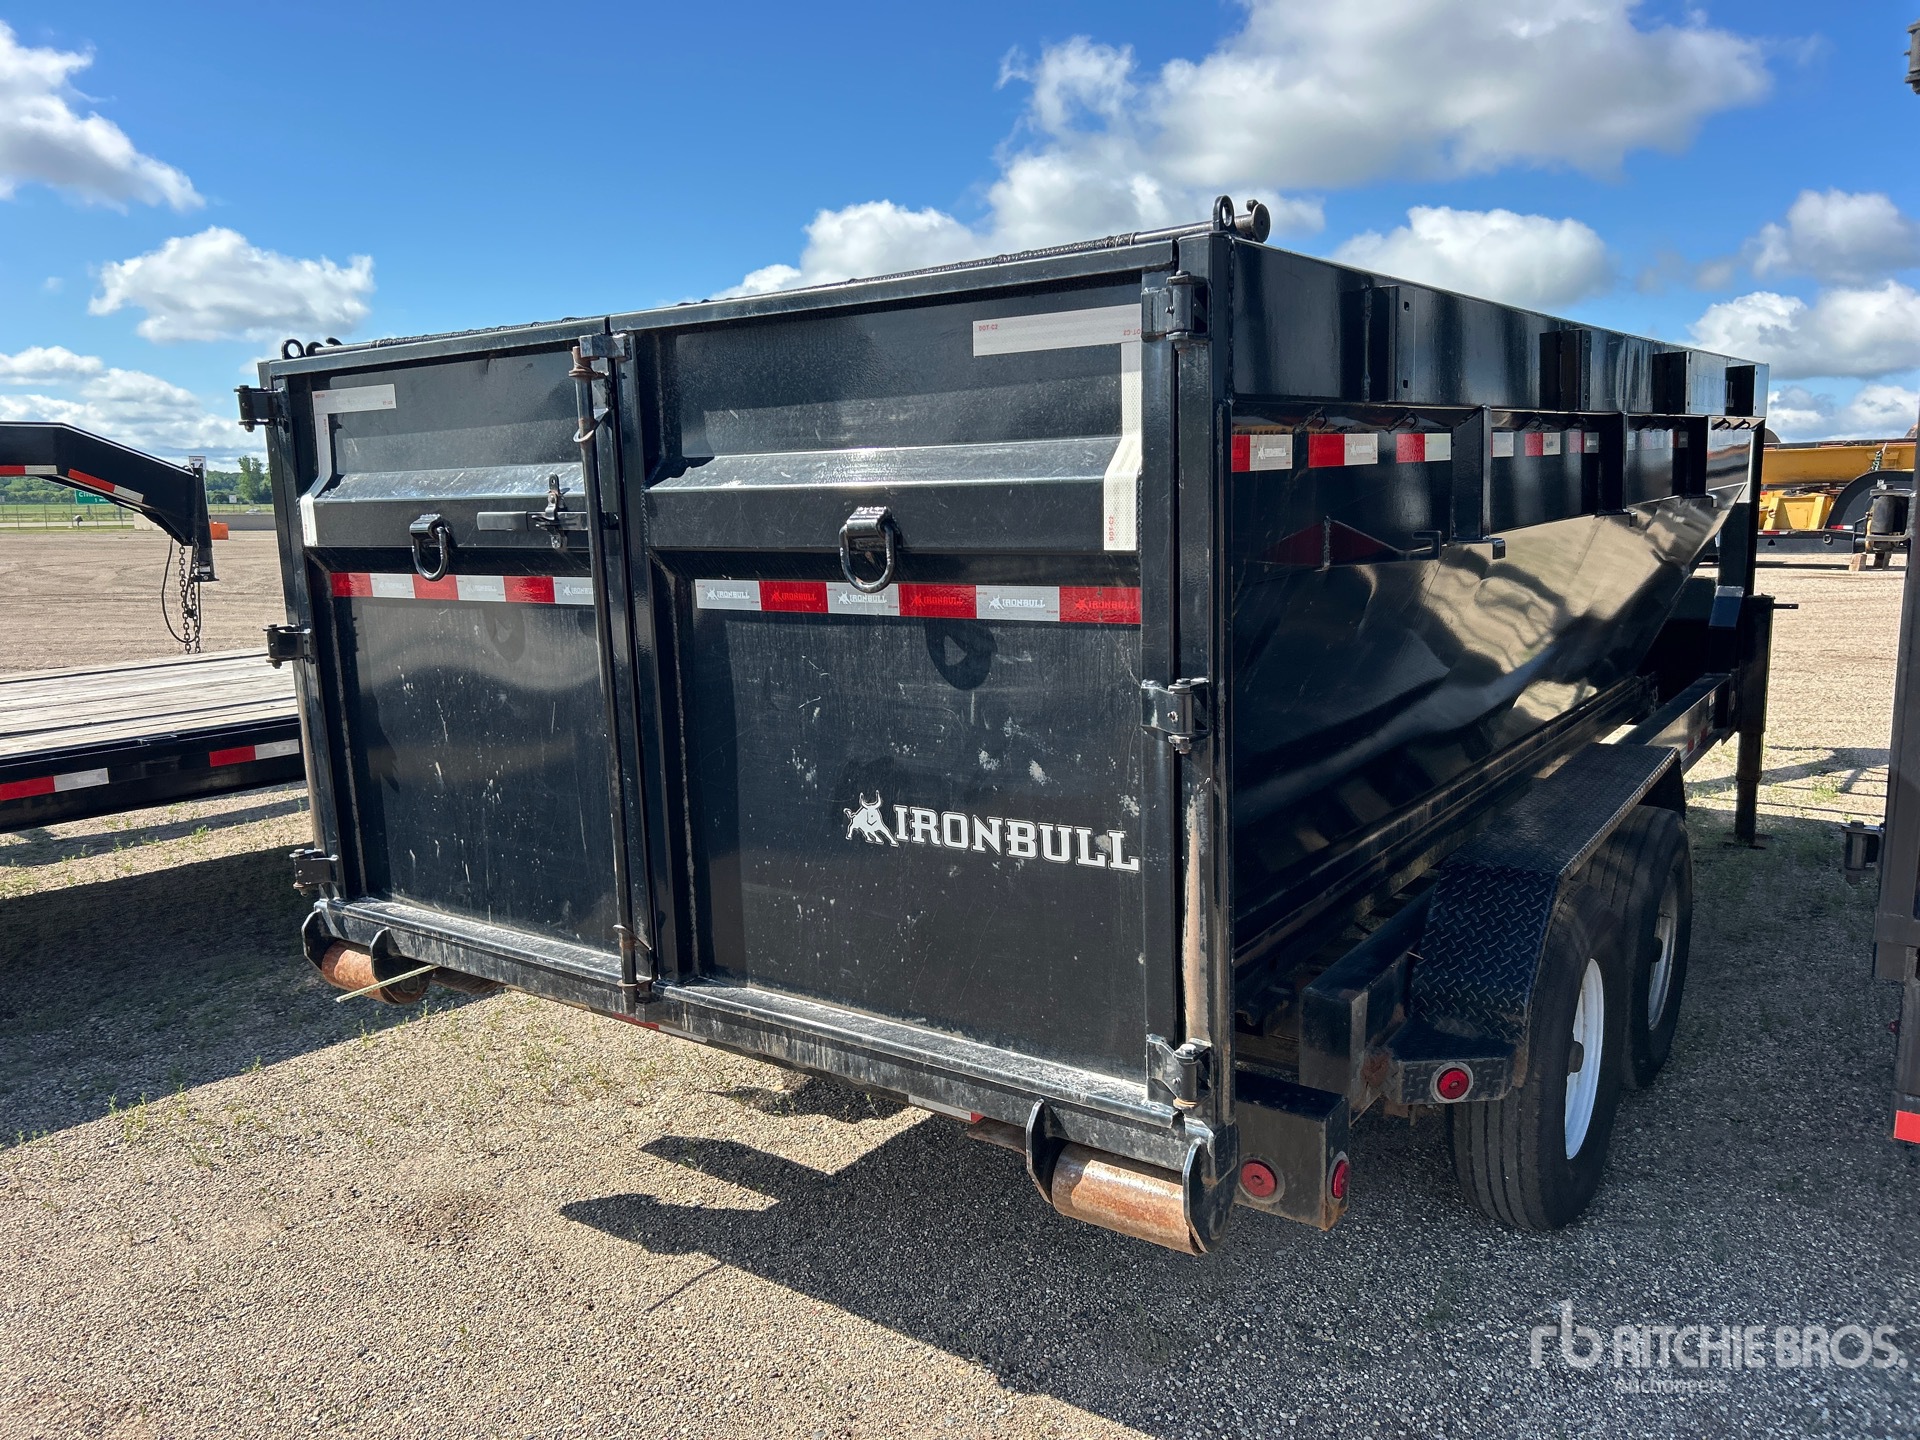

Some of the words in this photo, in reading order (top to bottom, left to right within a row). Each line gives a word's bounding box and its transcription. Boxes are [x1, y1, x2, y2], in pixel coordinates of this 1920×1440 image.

[716, 590, 750, 600] IRONBULL
[781, 592, 817, 601] IRONBULL
[849, 594, 888, 604] IRONBULL
[1002, 597, 1046, 609] IRONBULL
[1088, 600, 1136, 610] IRONBULL
[892, 804, 1140, 872] IRONBULL
